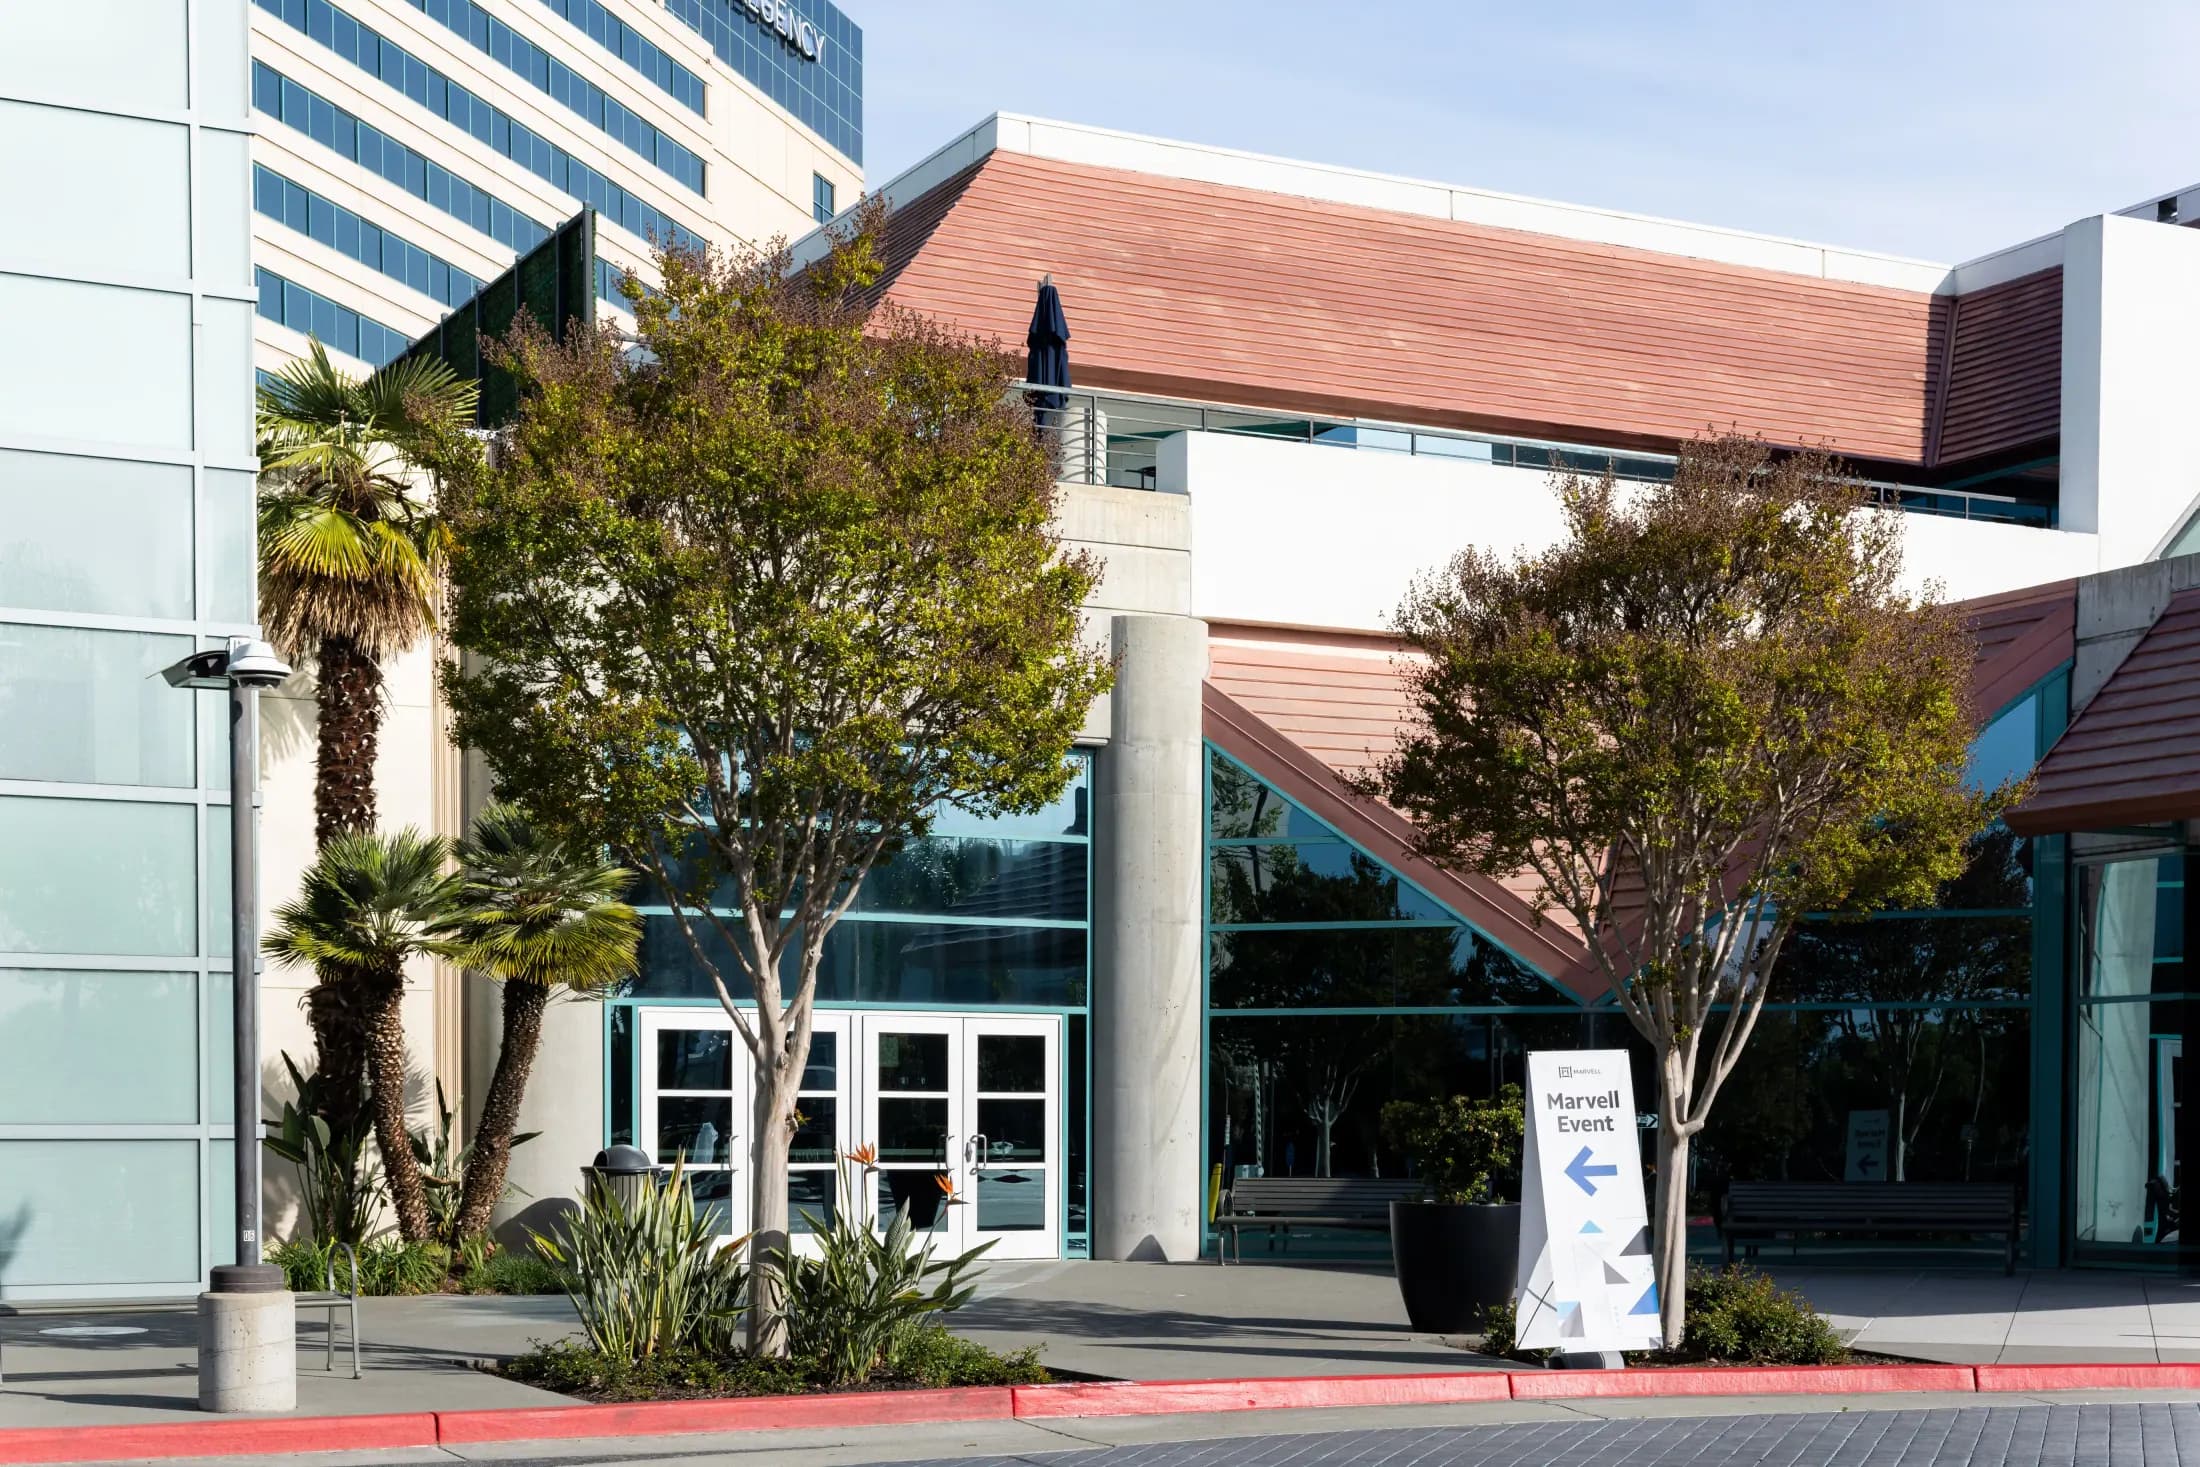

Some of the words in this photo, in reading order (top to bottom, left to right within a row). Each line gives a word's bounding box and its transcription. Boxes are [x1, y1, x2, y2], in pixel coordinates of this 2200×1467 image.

[744, 0, 825, 64] GENCY
[1547, 1090, 1620, 1110] Marvell
[1558, 1115, 1615, 1133] Event
